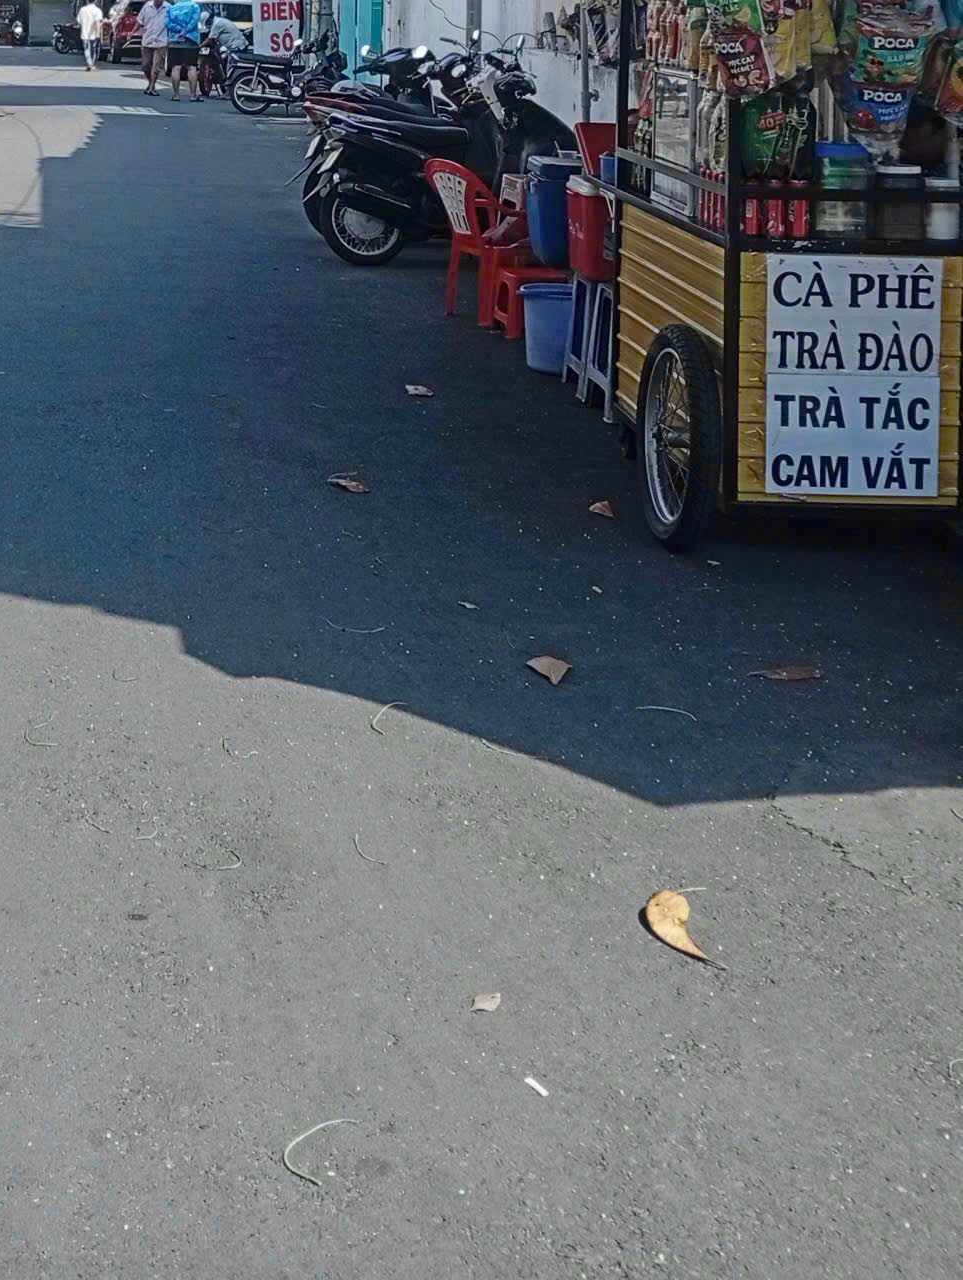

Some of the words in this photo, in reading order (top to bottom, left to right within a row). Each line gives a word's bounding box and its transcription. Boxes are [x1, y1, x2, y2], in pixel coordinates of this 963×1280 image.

[269, 24, 294, 53] SỐ
[714, 42, 744, 54] POCA
[873, 36, 915, 49] POCA
[862, 88, 903, 103] POCA
[772, 261, 833, 308] CÀ
[848, 263, 936, 310] PHÊ
[772, 319, 845, 370] TRÀ
[857, 320, 934, 372] ĐÀO
[774, 386, 846, 429] TRÀ
[859, 382, 931, 431] TẮC
[771, 454, 849, 488] CAM
[862, 442, 931, 490] VẮT
